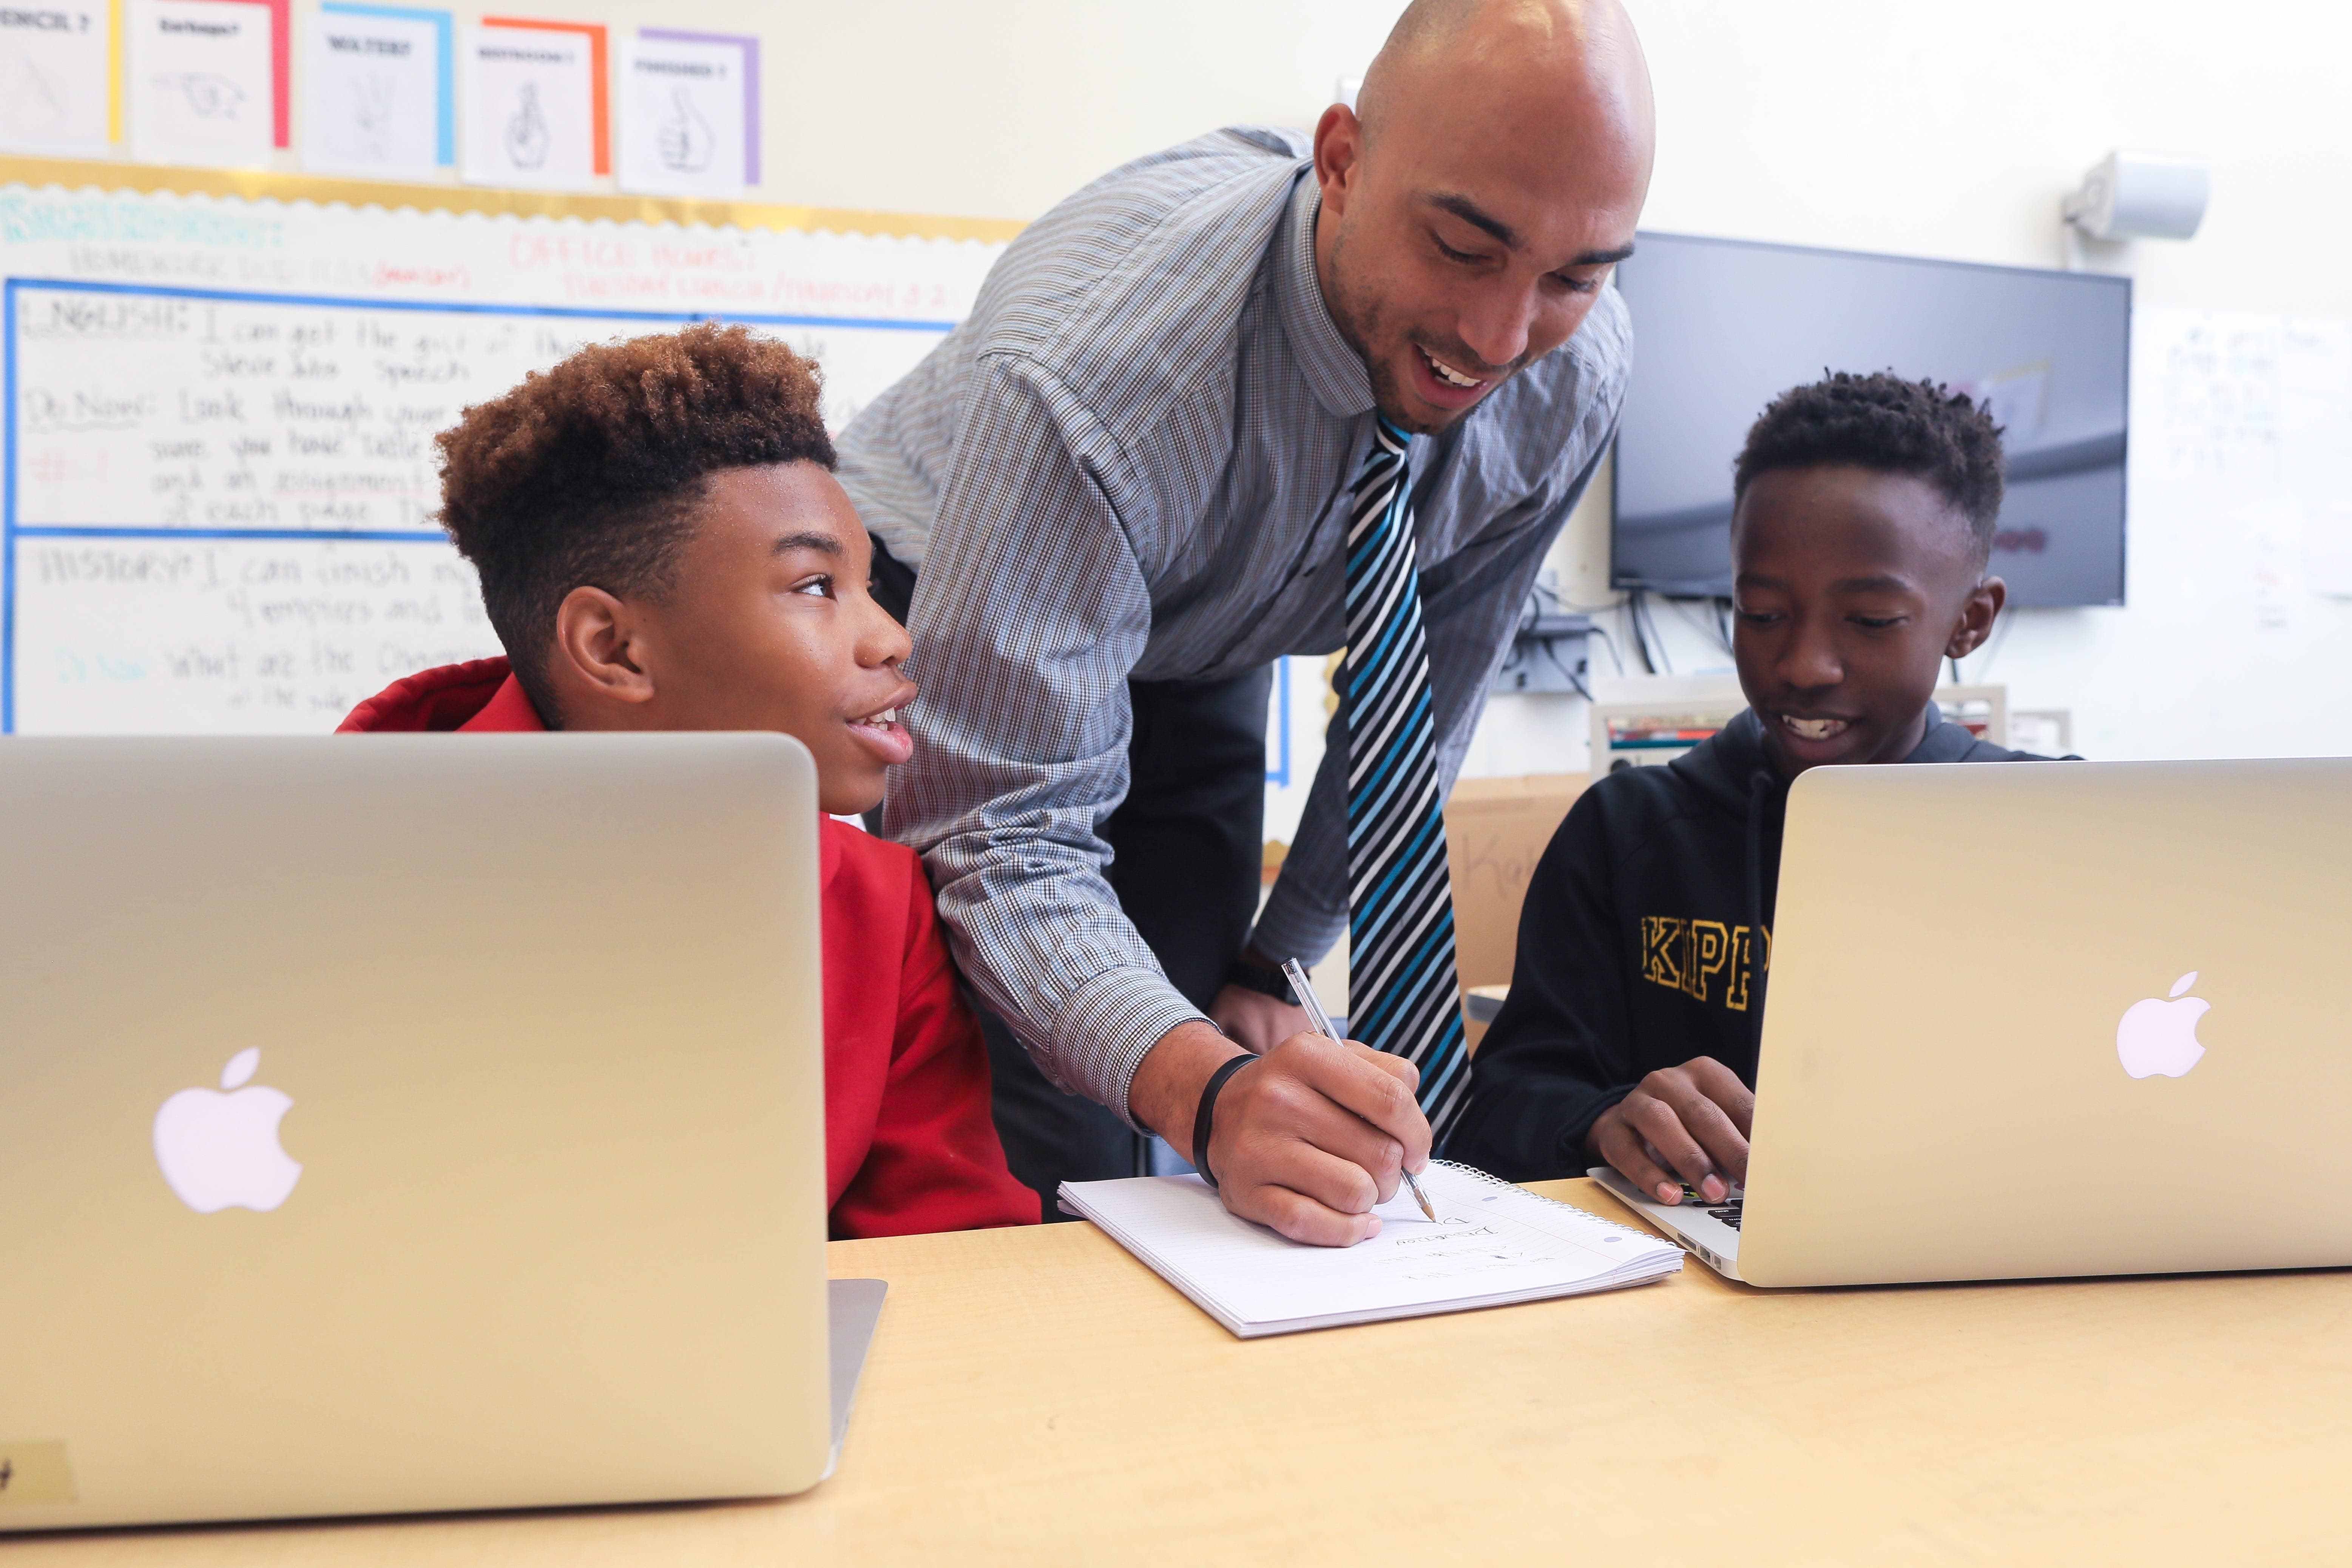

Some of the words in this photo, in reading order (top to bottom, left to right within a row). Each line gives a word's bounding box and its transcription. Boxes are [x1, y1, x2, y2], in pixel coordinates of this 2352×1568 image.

[0, 8, 70, 32] ENCIL
[508, 232, 634, 270] OFFICE
[232, 321, 279, 342] can
[291, 317, 335, 354] get
[239, 556, 301, 586] can
